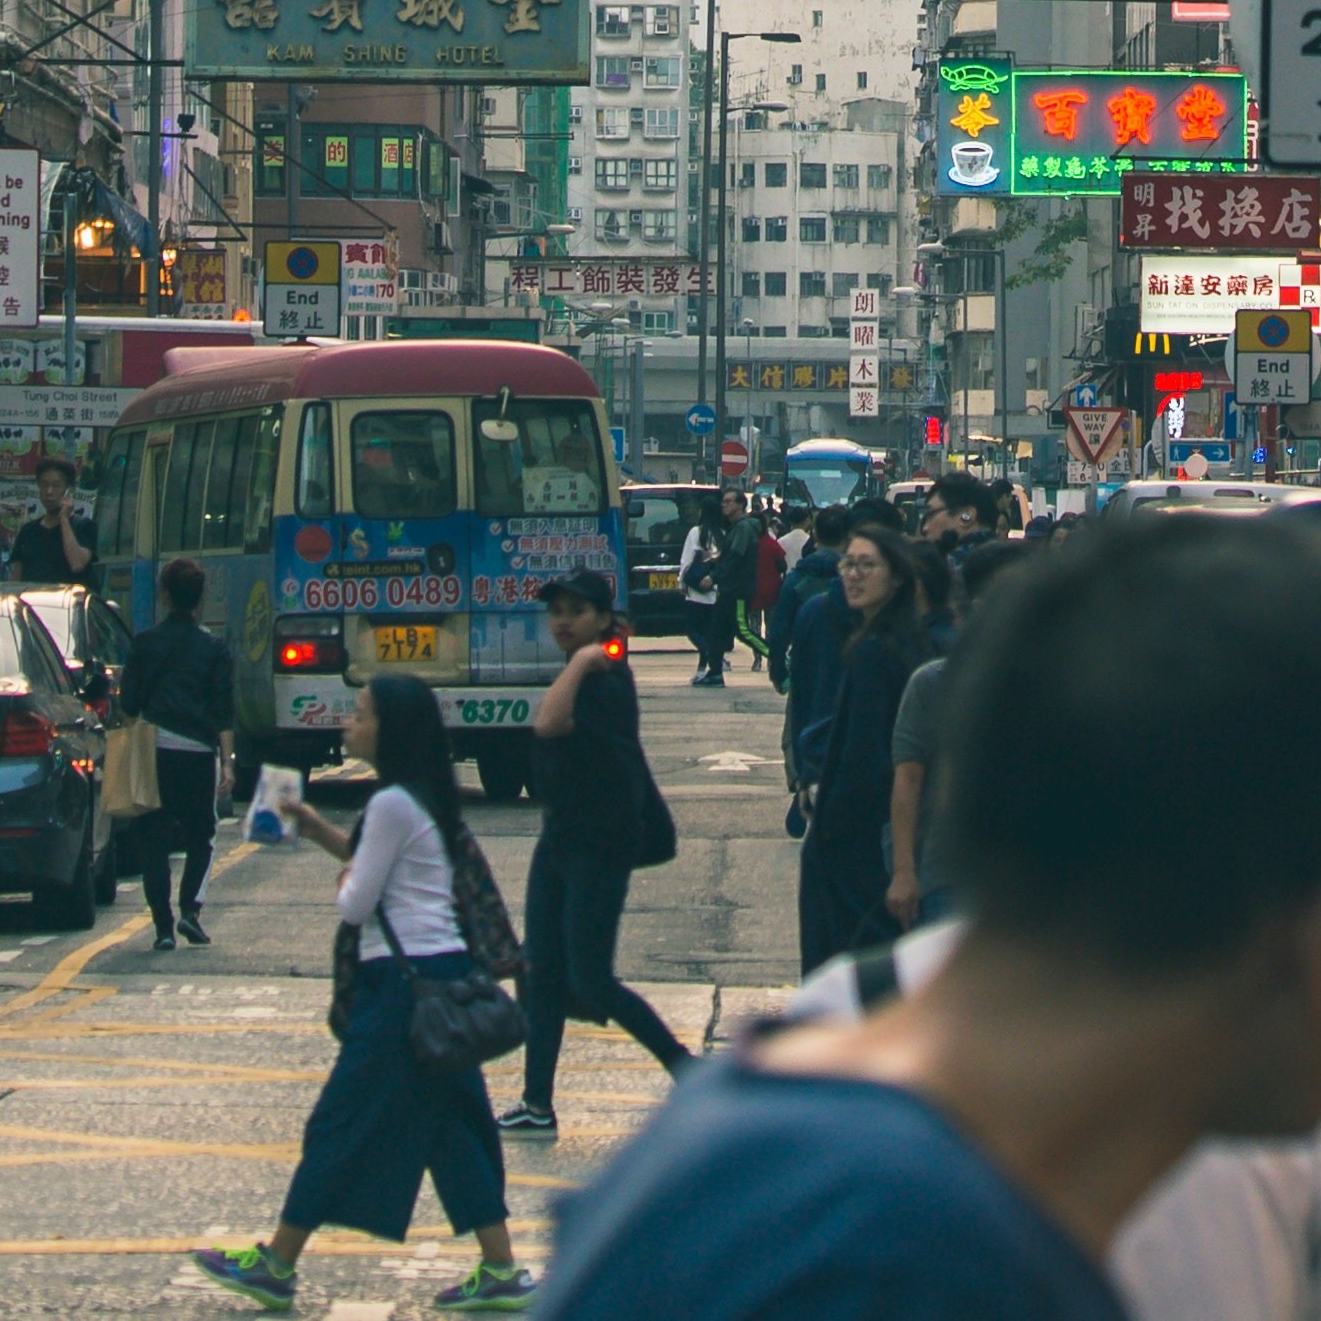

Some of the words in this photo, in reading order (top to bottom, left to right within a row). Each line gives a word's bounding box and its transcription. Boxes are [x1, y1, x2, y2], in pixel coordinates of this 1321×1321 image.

[266, 44, 315, 64] KAM
[343, 44, 407, 64] SHING
[436, 45, 504, 66] HOTEL
[1032, 85, 1226, 146] 百寶堂
[5, 175, 23, 190] be
[1132, 182, 1156, 240] 明昇
[1164, 185, 1314, 239] 找換店
[287, 290, 319, 305] End
[279, 309, 324, 330] 終止
[854, 291, 876, 413] 朗曜木業
[1257, 358, 1289, 374] End
[22, 390, 49, 403] Tung
[53, 390, 79, 402] Choi
[82, 391, 118, 403] Street
[1250, 379, 1295, 399] 終止
[45, 407, 94, 421] 通菜街
[1082, 413, 1108, 422] GIVE
[1084, 423, 1106, 432] WAY
[305, 579, 377, 609] 6606
[387, 576, 460, 607] 0489
[392, 628, 418, 646] LB
[378, 642, 432, 661] 7174
[461, 700, 529, 724] 6370
